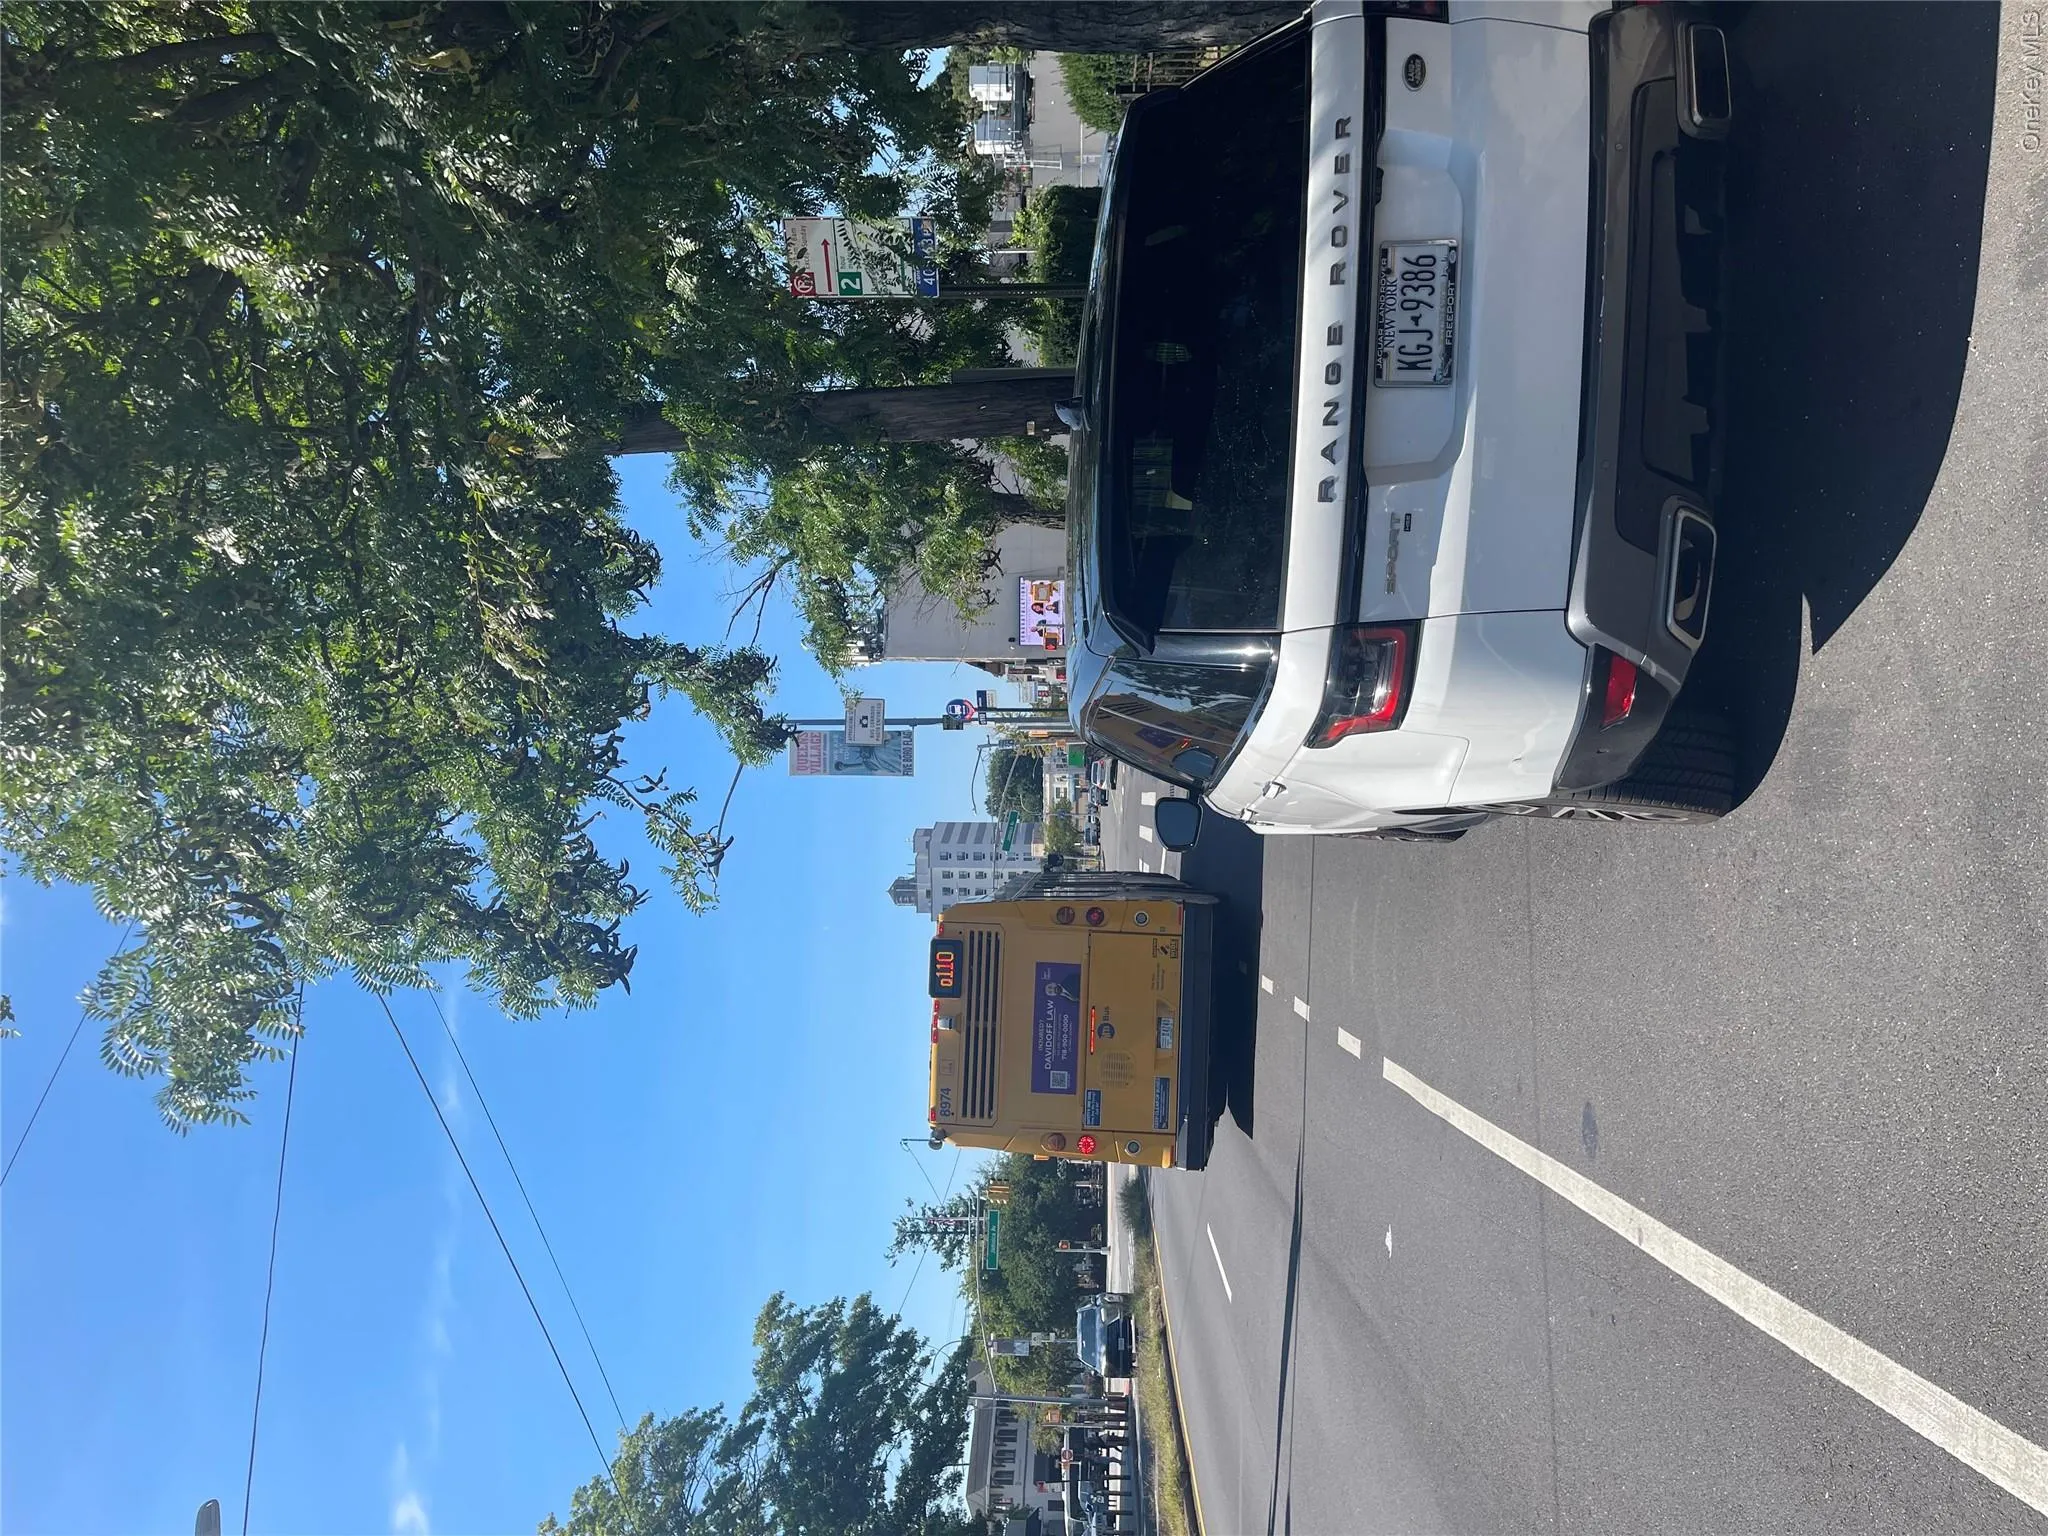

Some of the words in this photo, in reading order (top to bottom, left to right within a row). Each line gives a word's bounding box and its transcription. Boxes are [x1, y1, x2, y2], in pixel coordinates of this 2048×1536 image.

[1328, 116, 1352, 287] ROVER
[840, 277, 861, 290] 2
[1384, 278, 1398, 314] YORK
[1378, 295, 1386, 323] LAND
[1445, 280, 1455, 346] FREEPORT
[1375, 329, 1385, 369] JAGUAR
[1383, 315, 1396, 349] NEW
[1317, 321, 1343, 504] RANGE
[1384, 511, 1401, 595] SPORT
[796, 732, 809, 772] QUEENS
[810, 732, 822, 774] VILLAGE
[1046, 999, 1055, 1021] LAW
[1044, 1022, 1054, 1071] DAVIDOFF
[940, 1087, 952, 1117] 8974
